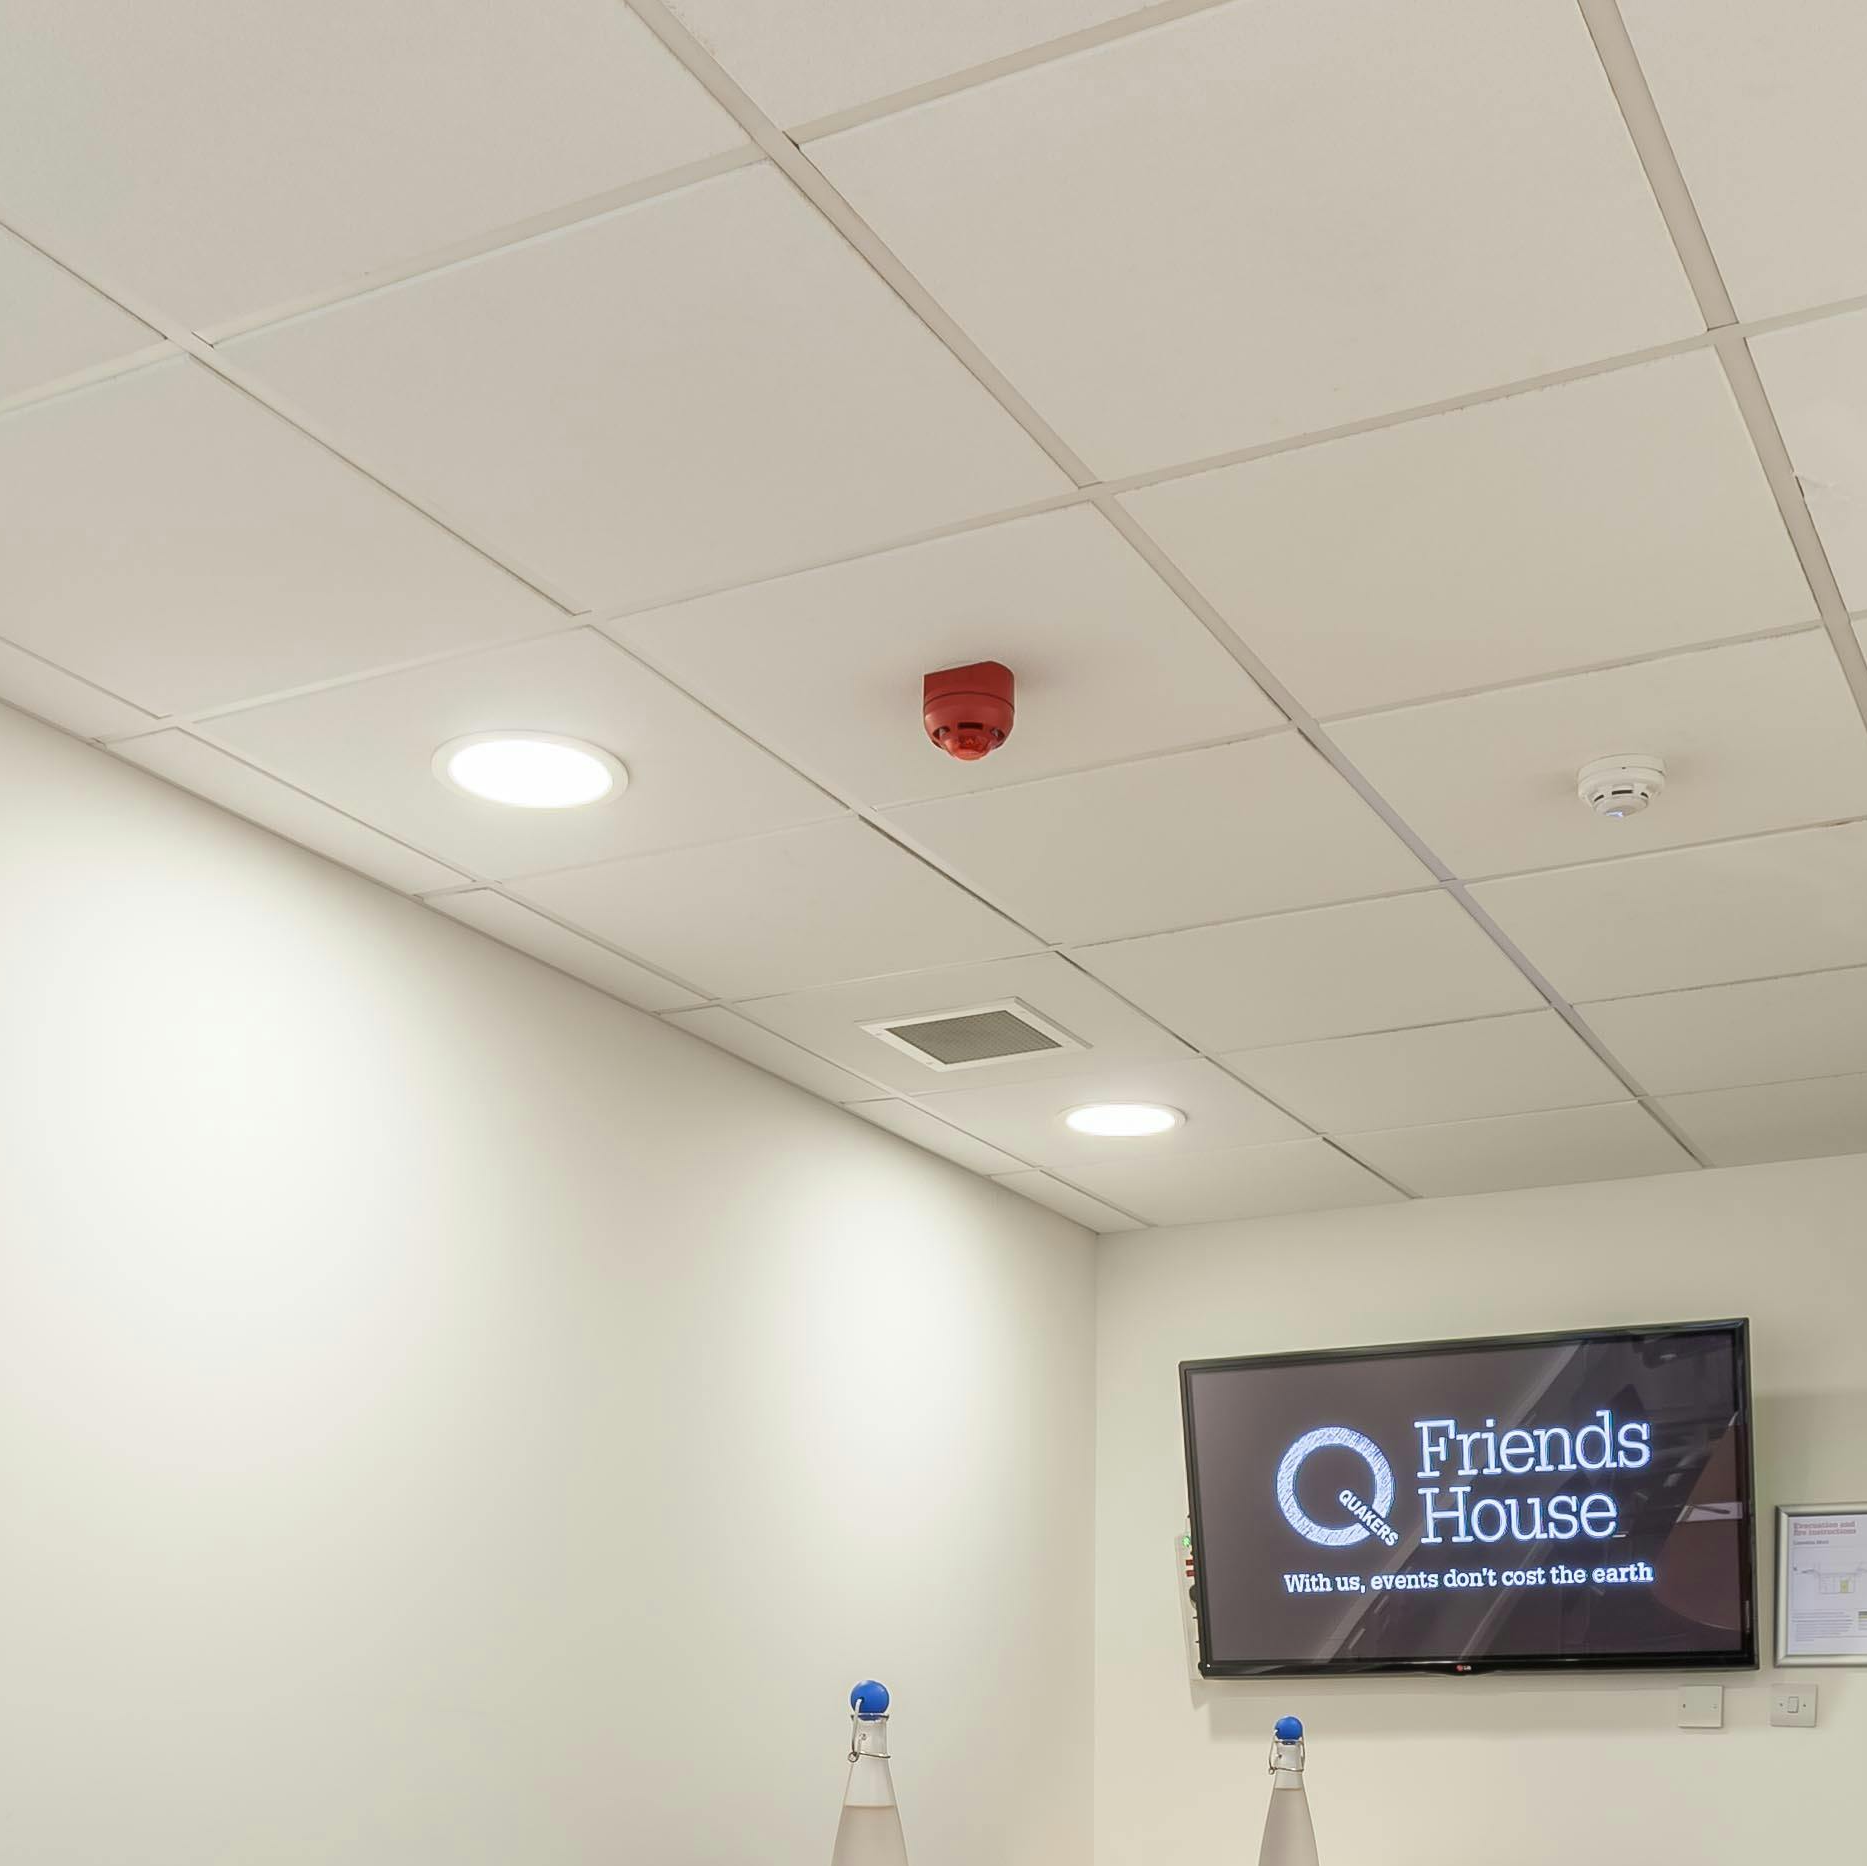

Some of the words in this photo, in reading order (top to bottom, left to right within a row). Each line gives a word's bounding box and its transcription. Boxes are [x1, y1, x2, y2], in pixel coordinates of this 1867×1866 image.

[1413, 1409, 1652, 1478] Friends
[1338, 1489, 1399, 1546] QUAKERS
[1417, 1486, 1618, 1544] House
[1284, 1573, 1334, 1593] With
[1335, 1576, 1366, 1593] us,
[1370, 1571, 1439, 1590] events
[1442, 1567, 1498, 1588] don't
[1501, 1570, 1546, 1586] cost
[1549, 1564, 1587, 1585] the
[1591, 1561, 1654, 1584] earth
